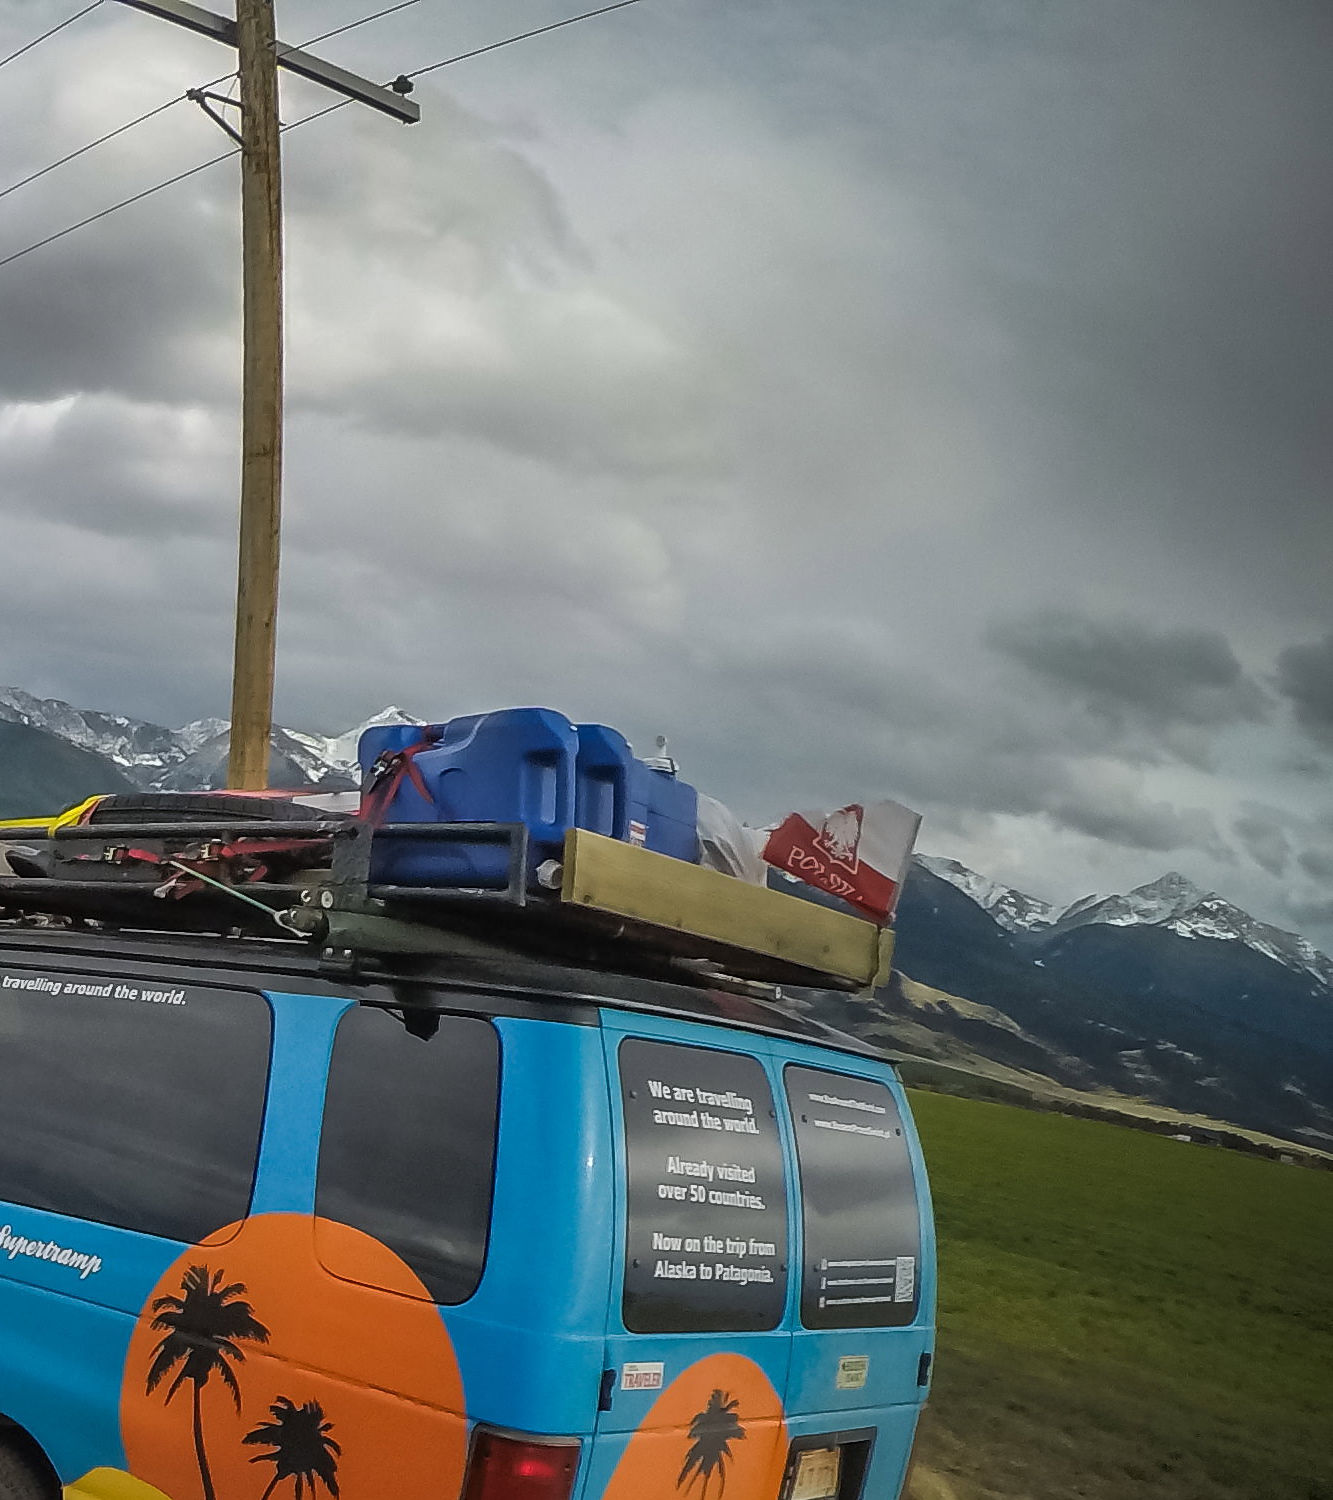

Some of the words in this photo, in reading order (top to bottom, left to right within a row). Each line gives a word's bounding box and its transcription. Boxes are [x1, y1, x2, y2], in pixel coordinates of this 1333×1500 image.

[2, 975, 62, 996] travelling
[63, 983, 114, 997] around
[114, 984, 139, 1000] the
[141, 989, 187, 1006] world.
[647, 1080, 672, 1099] We
[672, 1087, 696, 1103] are
[695, 1086, 754, 1115] travelling
[652, 1109, 700, 1128] around
[700, 1112, 723, 1130] the
[722, 1117, 760, 1135] world.
[666, 1156, 714, 1182] Already
[715, 1163, 756, 1184] visited
[658, 1184, 688, 1201] over
[689, 1184, 706, 1203] 50
[708, 1189, 767, 1210] countries.
[652, 1232, 682, 1251] Now
[683, 1238, 701, 1252] on
[703, 1235, 725, 1254] the
[725, 1236, 747, 1259] trip
[747, 1238, 776, 1256] from
[653, 1260, 697, 1279] Alaska
[698, 1262, 714, 1280] to
[714, 1263, 774, 1286] Patagonia.
